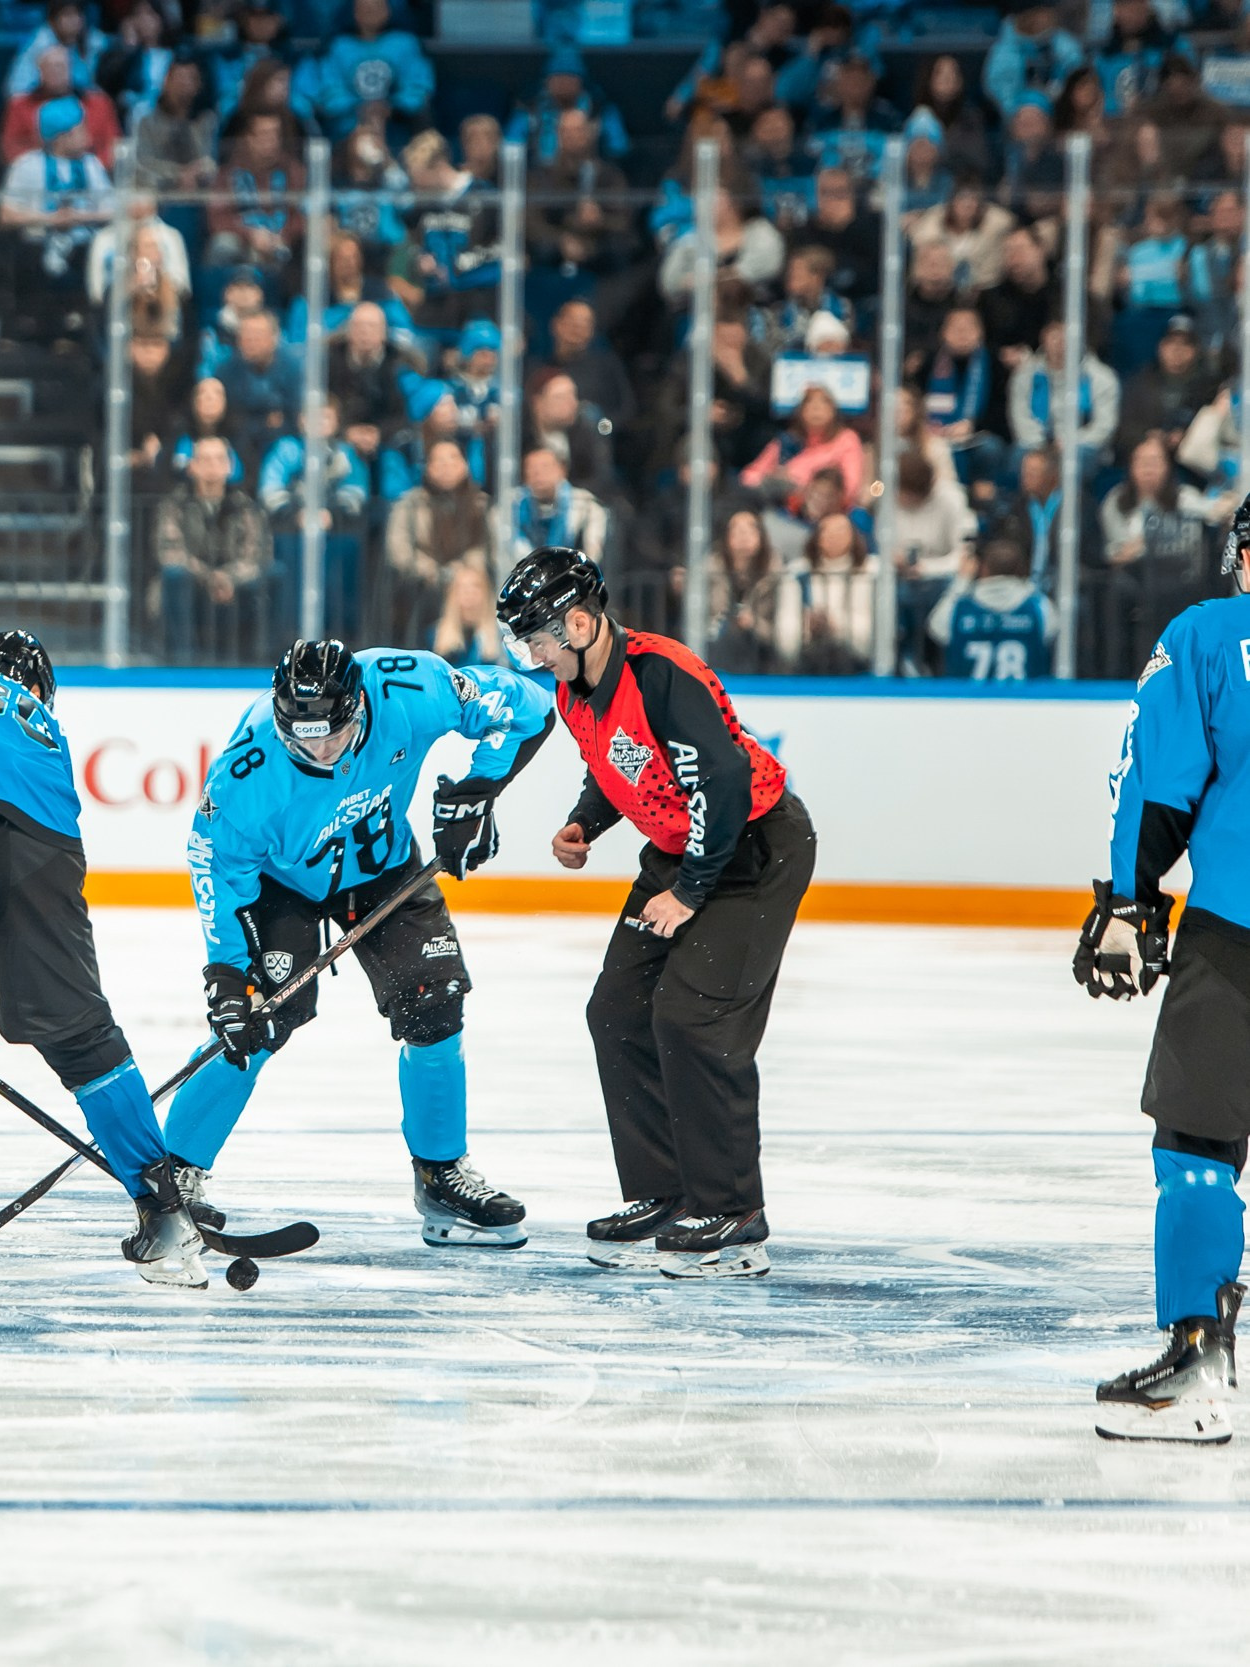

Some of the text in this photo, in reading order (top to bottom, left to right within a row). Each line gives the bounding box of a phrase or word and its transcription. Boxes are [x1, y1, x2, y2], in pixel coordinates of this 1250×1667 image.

[553, 588, 576, 607] CCM
[377, 655, 424, 700] 78
[223, 725, 266, 780] 78
